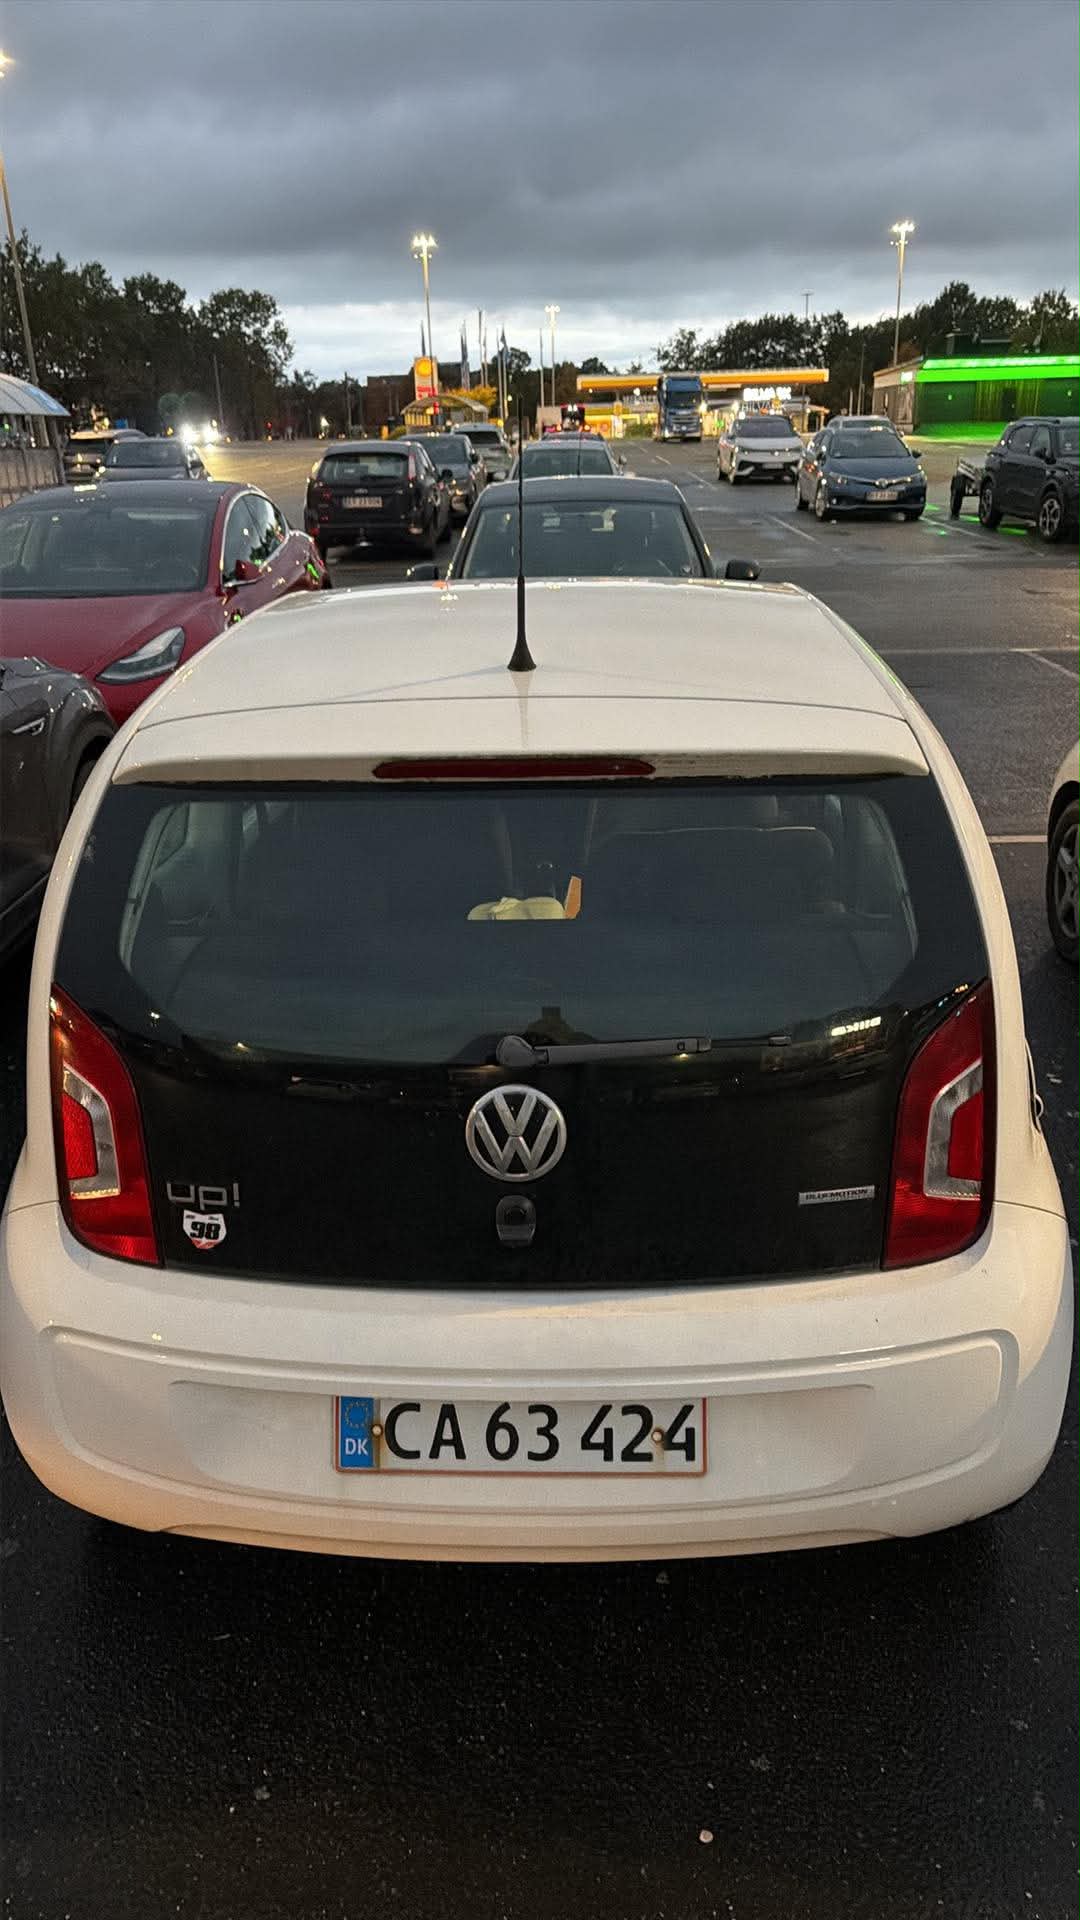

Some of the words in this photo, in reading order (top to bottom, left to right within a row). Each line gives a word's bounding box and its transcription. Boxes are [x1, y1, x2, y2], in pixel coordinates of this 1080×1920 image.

[189, 1221, 221, 1240] 98
[384, 1402, 467, 1460] CA
[485, 1401, 560, 1462] 63
[580, 1403, 696, 1463] 424
[345, 1437, 368, 1456] DK
